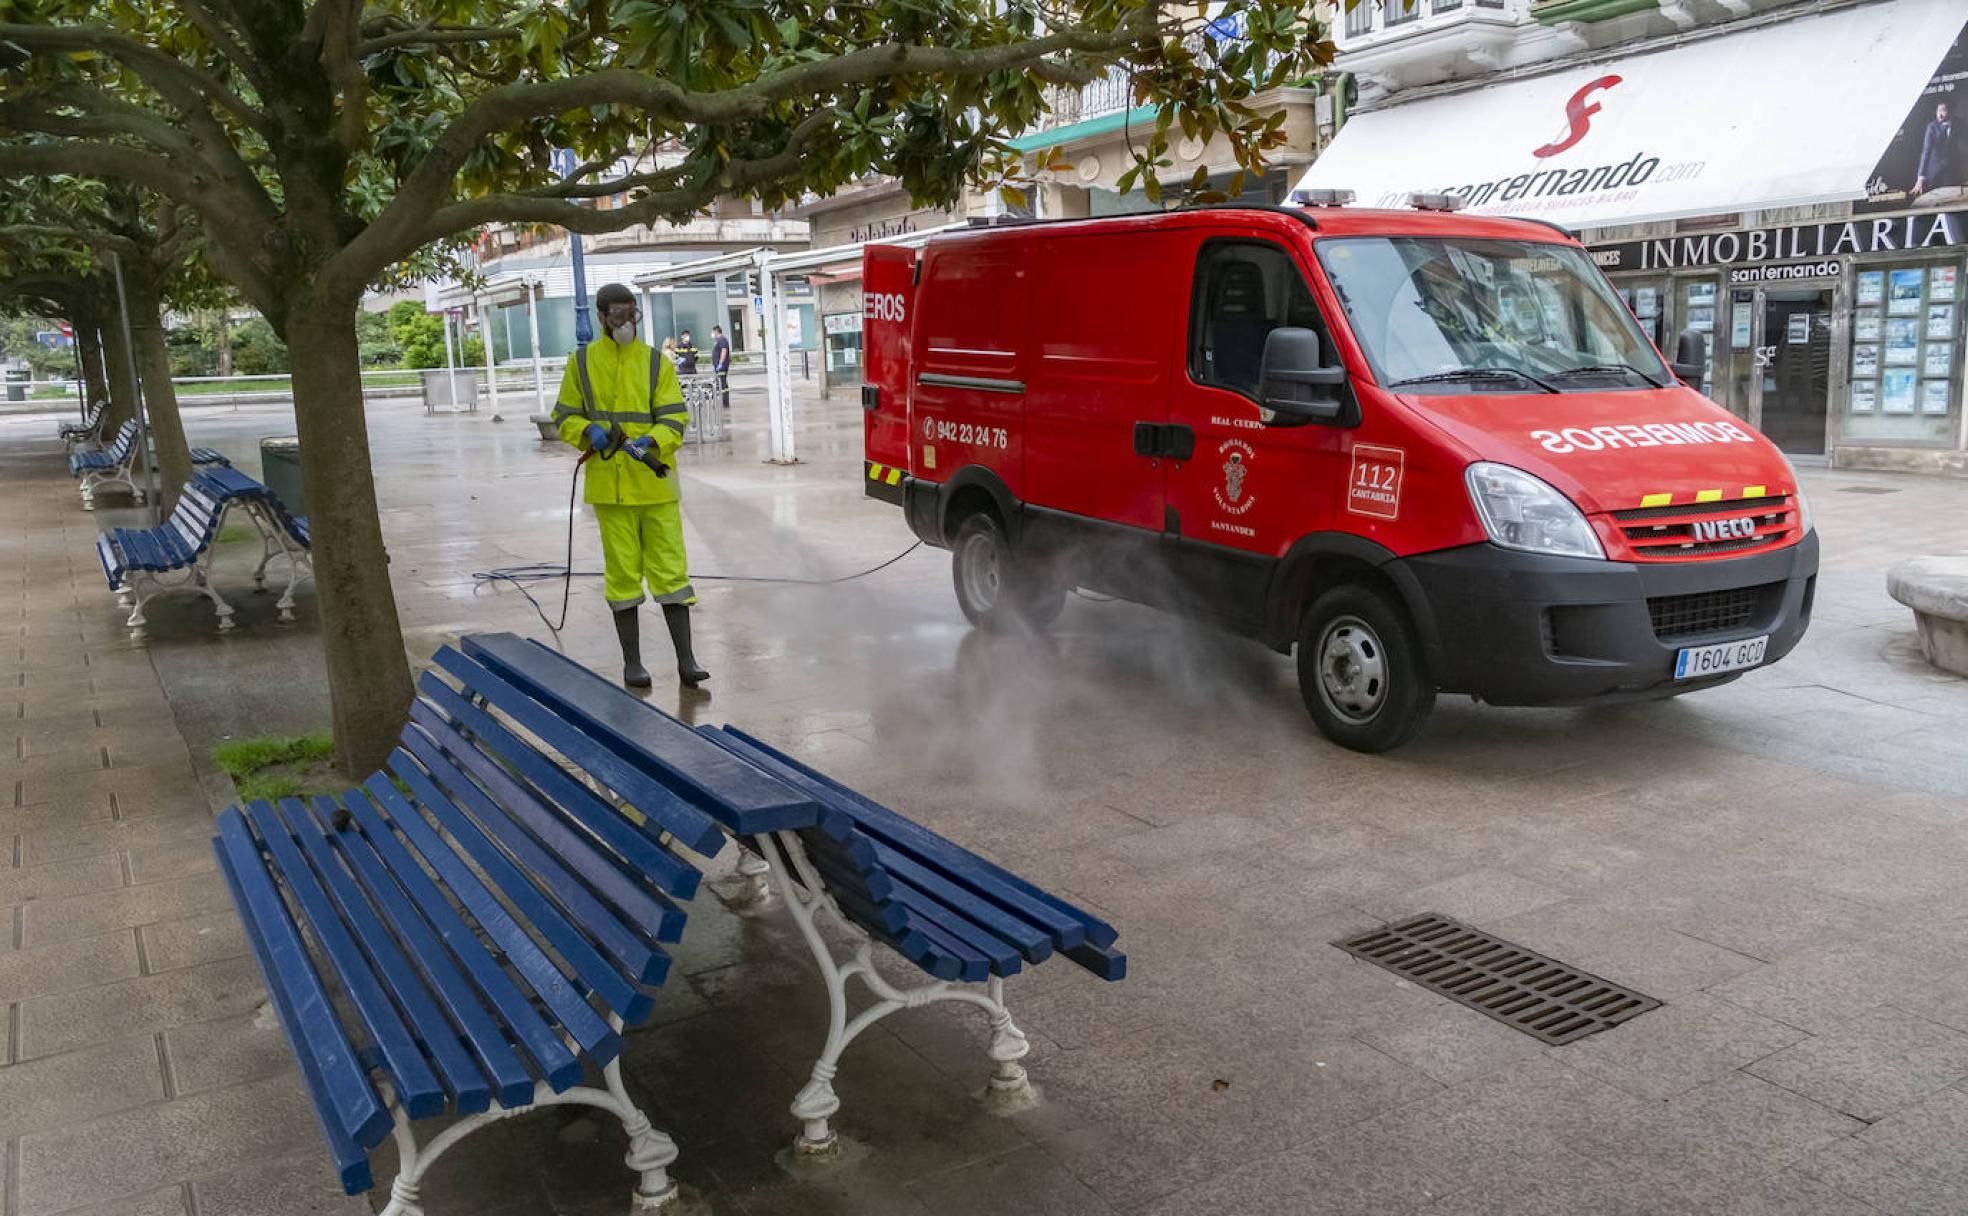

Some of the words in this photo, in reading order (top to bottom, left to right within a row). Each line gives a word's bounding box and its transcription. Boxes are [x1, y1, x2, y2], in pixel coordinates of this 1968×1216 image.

[1640, 213, 1955, 270] INMOBILIARIA
[1730, 260, 1840, 283] sanfernando
[863, 292, 905, 322] EROS
[1211, 415, 1231, 427] REAL
[937, 420, 957, 441] 942
[959, 423, 973, 444] 23
[975, 425, 990, 447] 24
[992, 428, 1007, 449] 76
[1356, 463, 1396, 490] 112
[1351, 488, 1398, 505] CANTABRIA
[1211, 520, 1256, 537] SANTANDER
[1693, 517, 1755, 541] IVECO
[1693, 647, 1732, 673] 1604
